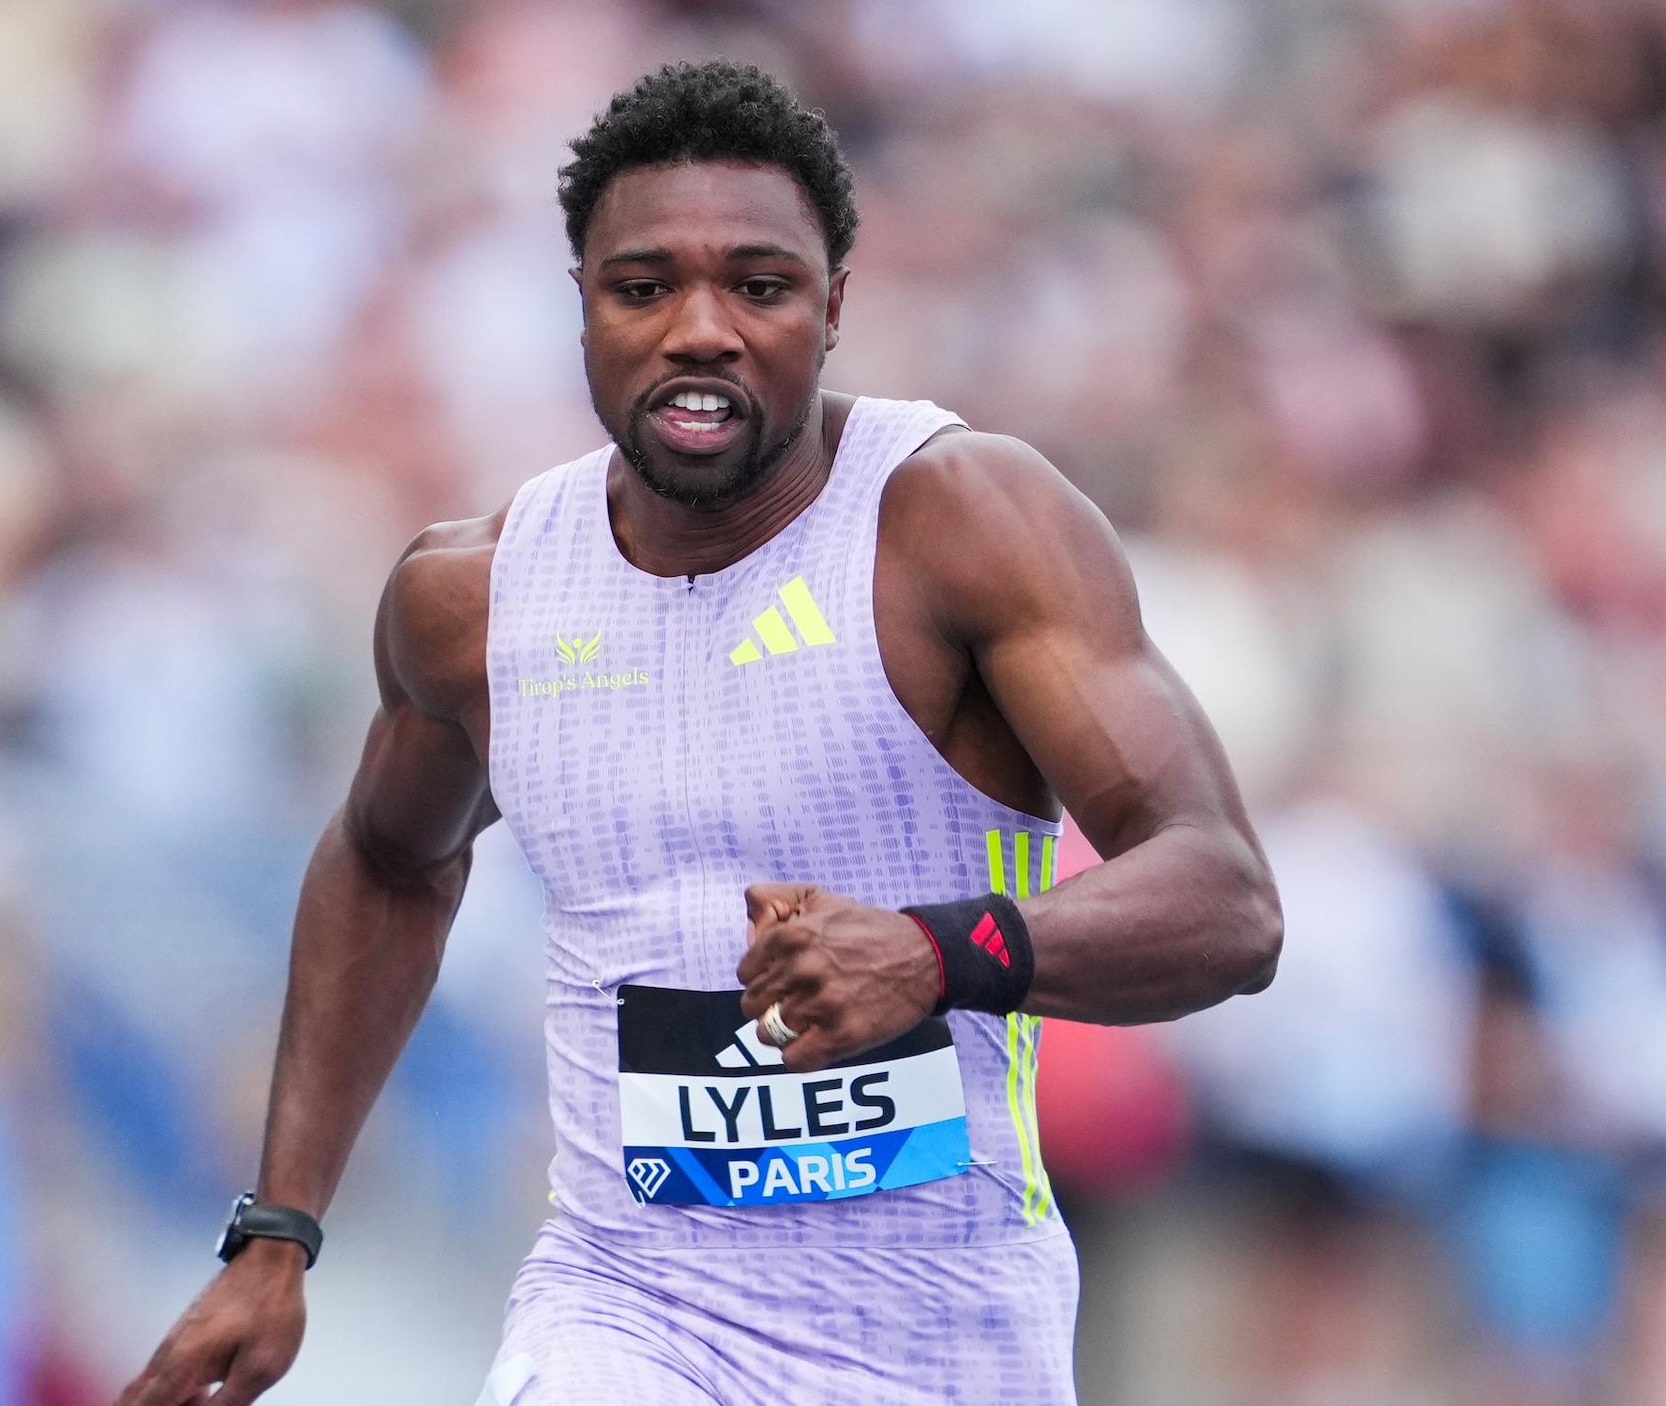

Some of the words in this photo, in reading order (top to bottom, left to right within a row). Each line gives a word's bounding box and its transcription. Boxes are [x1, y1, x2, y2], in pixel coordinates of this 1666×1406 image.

[519, 674, 577, 698] Tirop's
[581, 668, 649, 690] Angels
[678, 1071, 896, 1143] LYLES
[727, 1147, 877, 1198] PARIS
